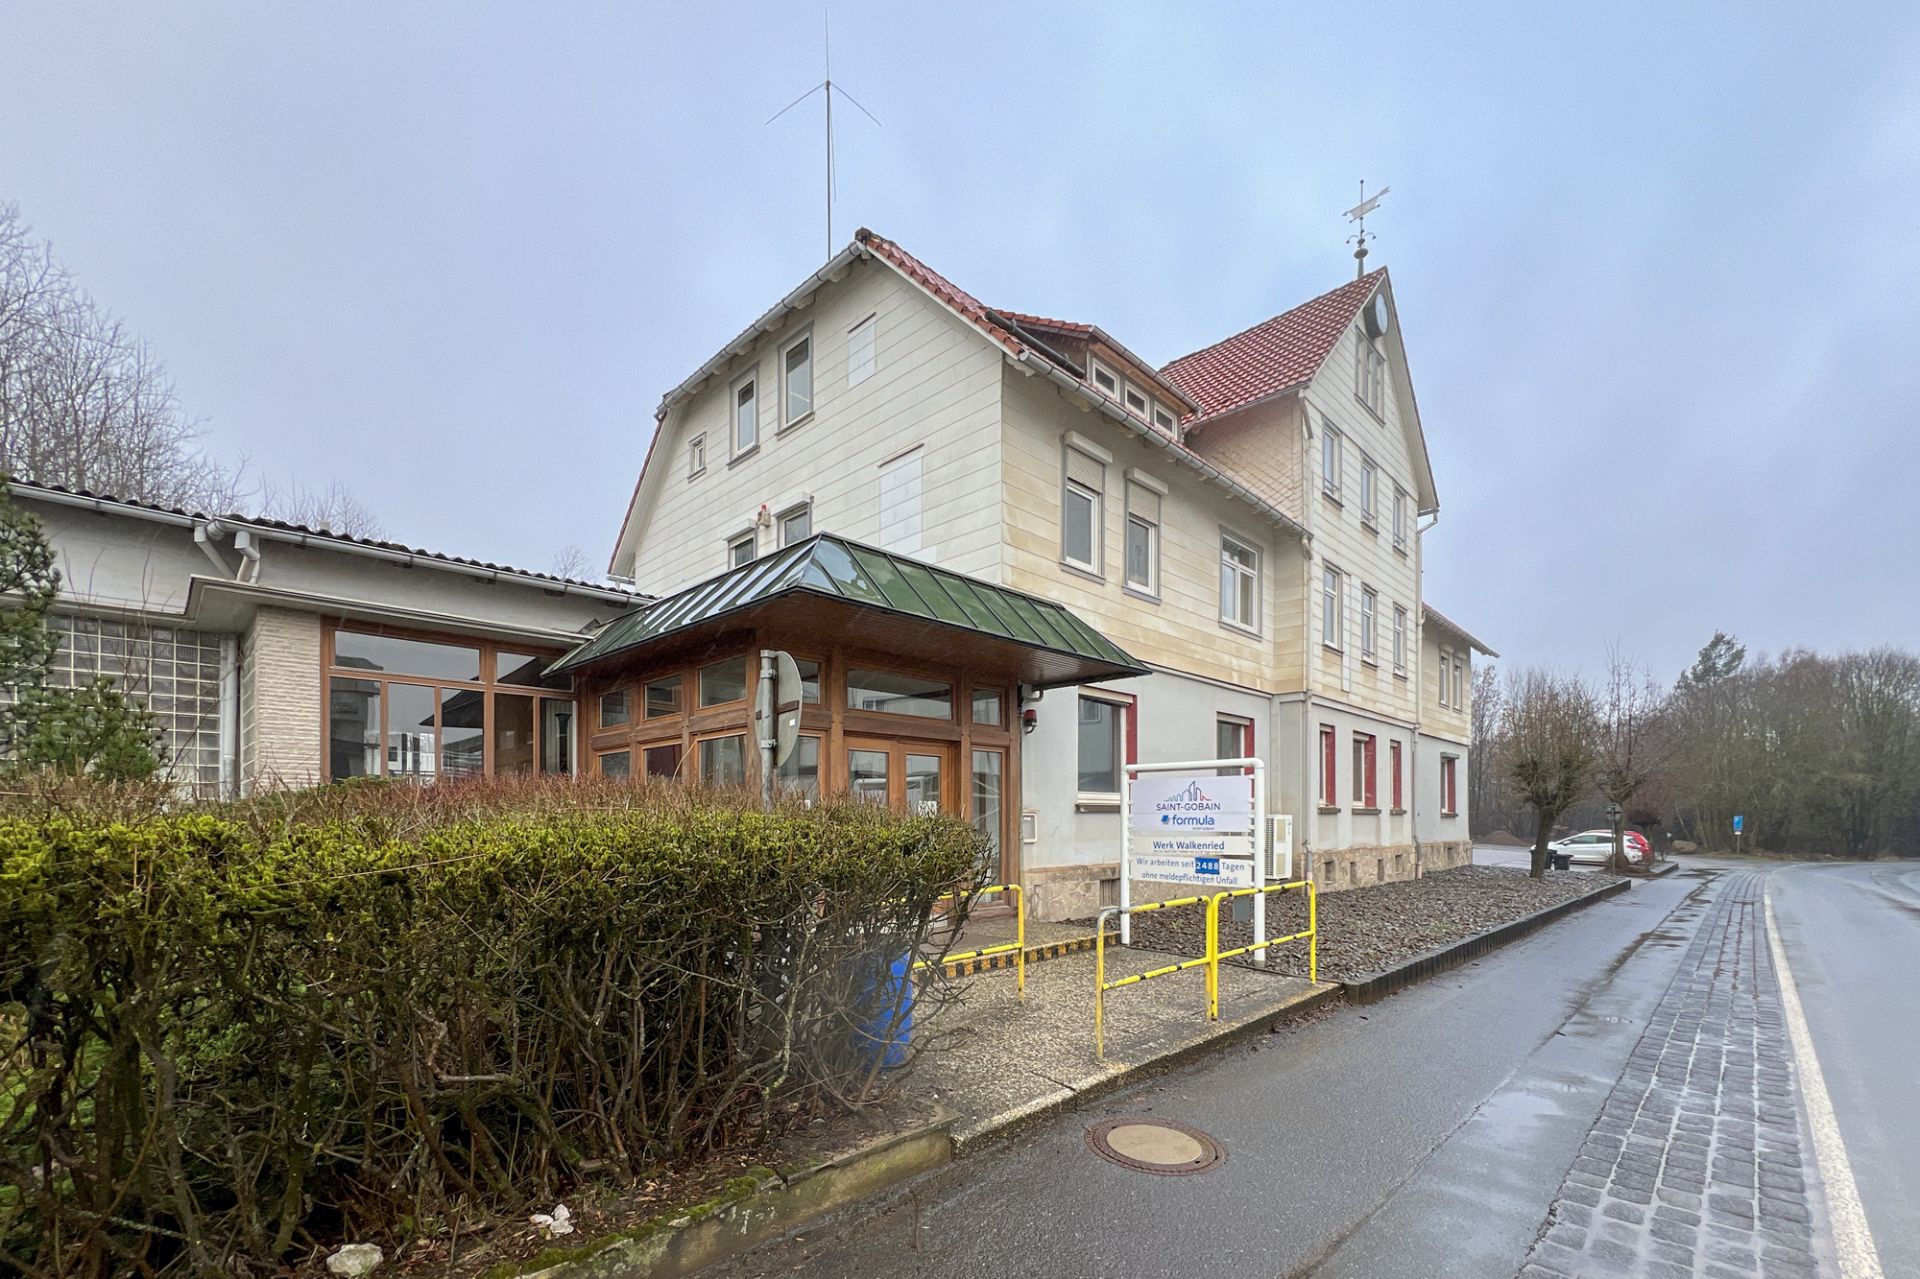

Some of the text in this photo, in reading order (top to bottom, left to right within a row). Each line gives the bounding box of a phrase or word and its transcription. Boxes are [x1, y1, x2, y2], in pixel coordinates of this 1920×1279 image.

[1156, 802, 1220, 811] SAINT-GOBAIN
[1172, 815, 1214, 825] formula
[1153, 841, 1224, 850] Werk Walkenried
[1136, 858, 1245, 872] Wir arbeiten seit 2488 Tagen
[1142, 871, 1238, 885] ohne meldepflichtigen Unfall
